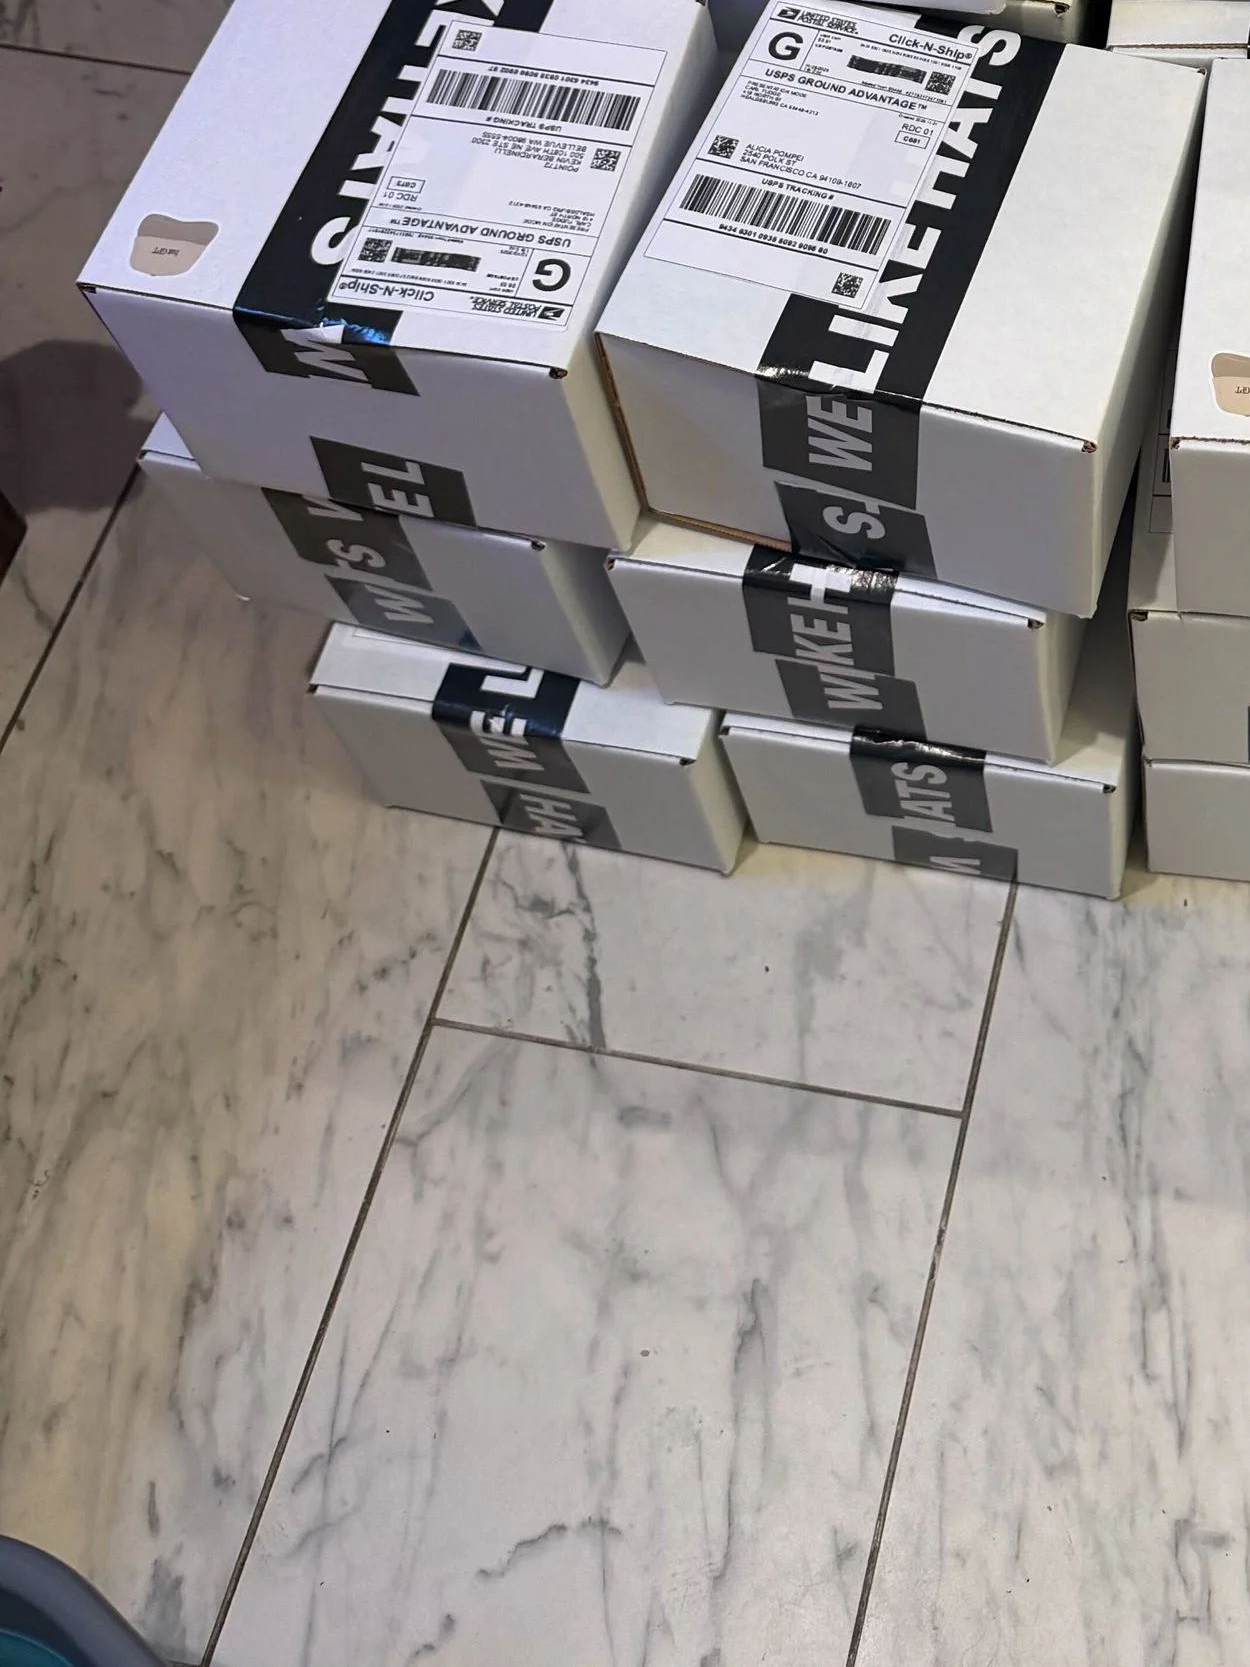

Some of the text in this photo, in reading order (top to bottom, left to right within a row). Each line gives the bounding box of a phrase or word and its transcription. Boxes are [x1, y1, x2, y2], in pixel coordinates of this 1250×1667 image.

[767, 30, 804, 61] G
[764, 67, 796, 82] USPS
[797, 75, 847, 94] GROUND
[492, 115, 537, 129] TRACKING
[900, 122, 934, 137] RDC 01
[757, 159, 806, 177] FRANCISCO
[760, 177, 828, 200] USPS TRACKING
[479, 226, 535, 243] GROUND
[536, 234, 572, 248] USPS
[531, 257, 572, 292] G
[809, 221, 942, 392] LIKE
[805, 395, 874, 471] WE
